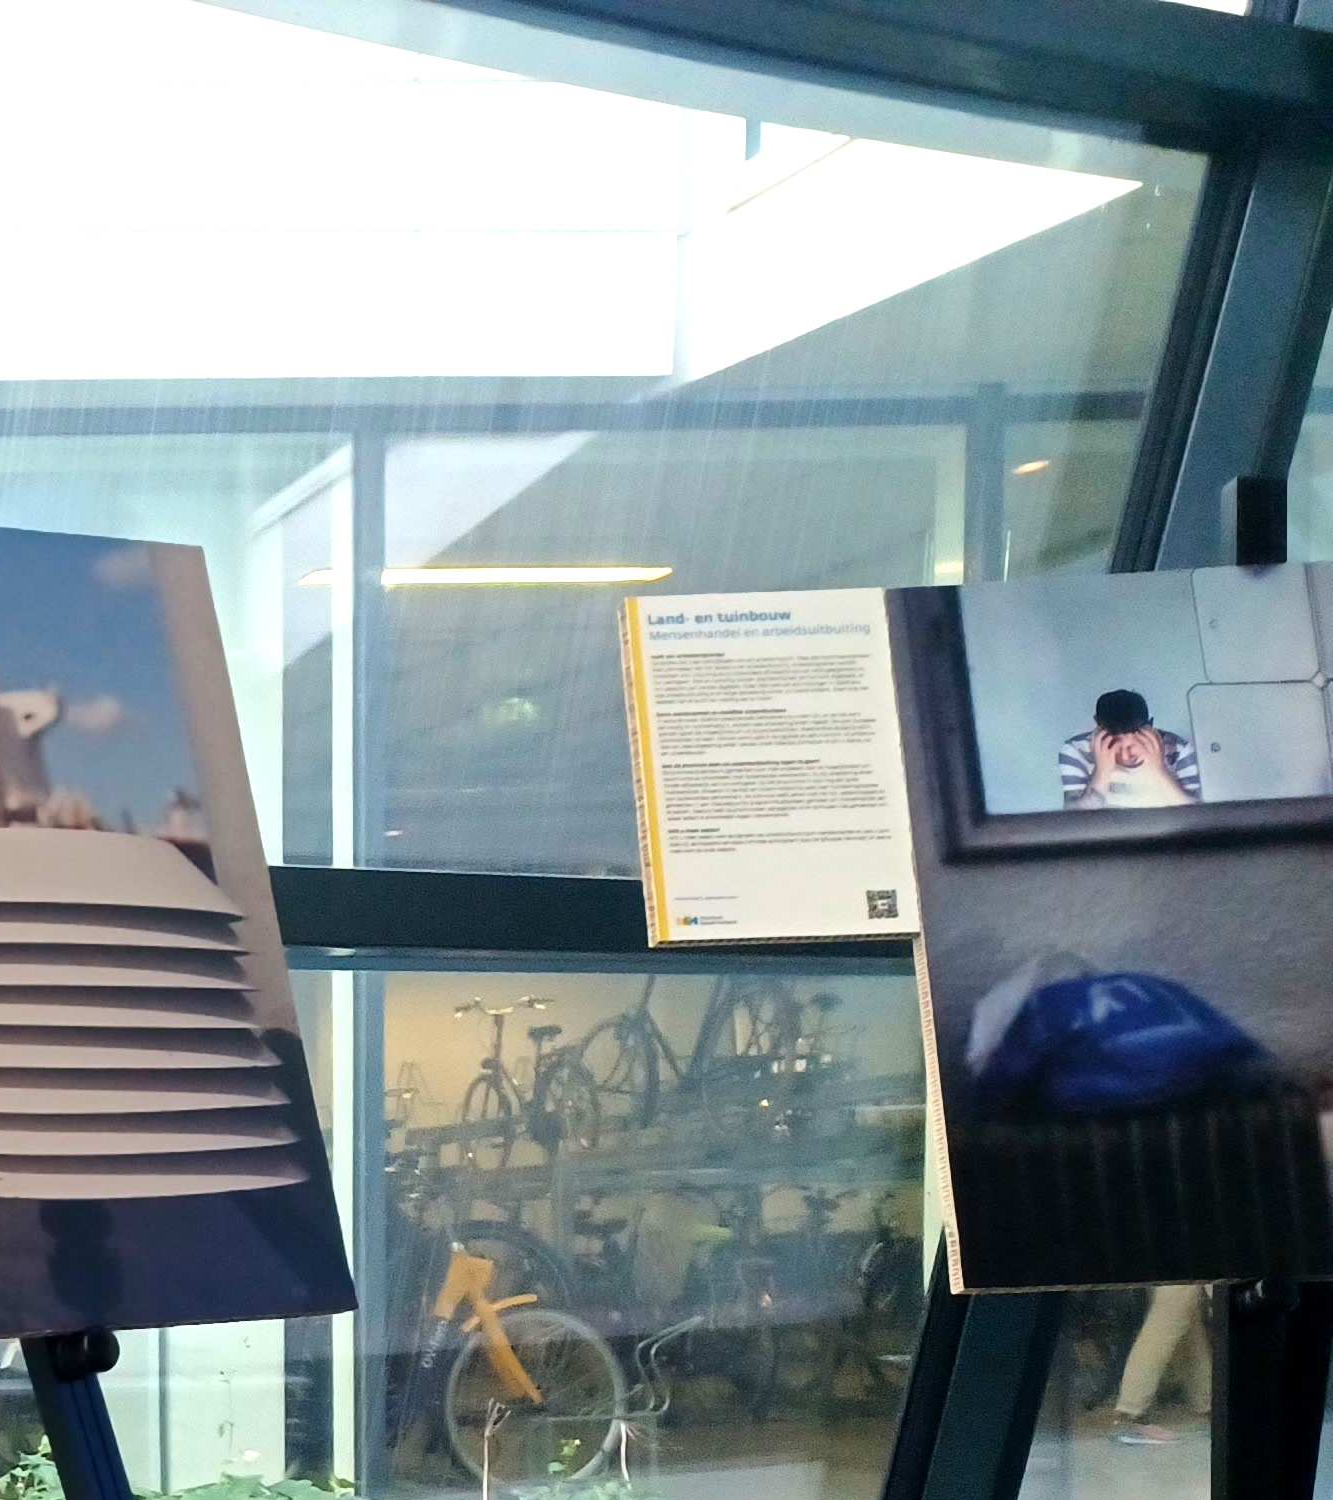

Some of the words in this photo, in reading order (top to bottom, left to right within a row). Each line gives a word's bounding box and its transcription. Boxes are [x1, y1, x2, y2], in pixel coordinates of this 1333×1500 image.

[648, 612, 689, 626] Land-
[695, 612, 712, 624] en
[717, 610, 791, 623] tuinbouw
[649, 627, 741, 641] Mensenhandel
[762, 622, 871, 638] arbeidsuitbuiting
